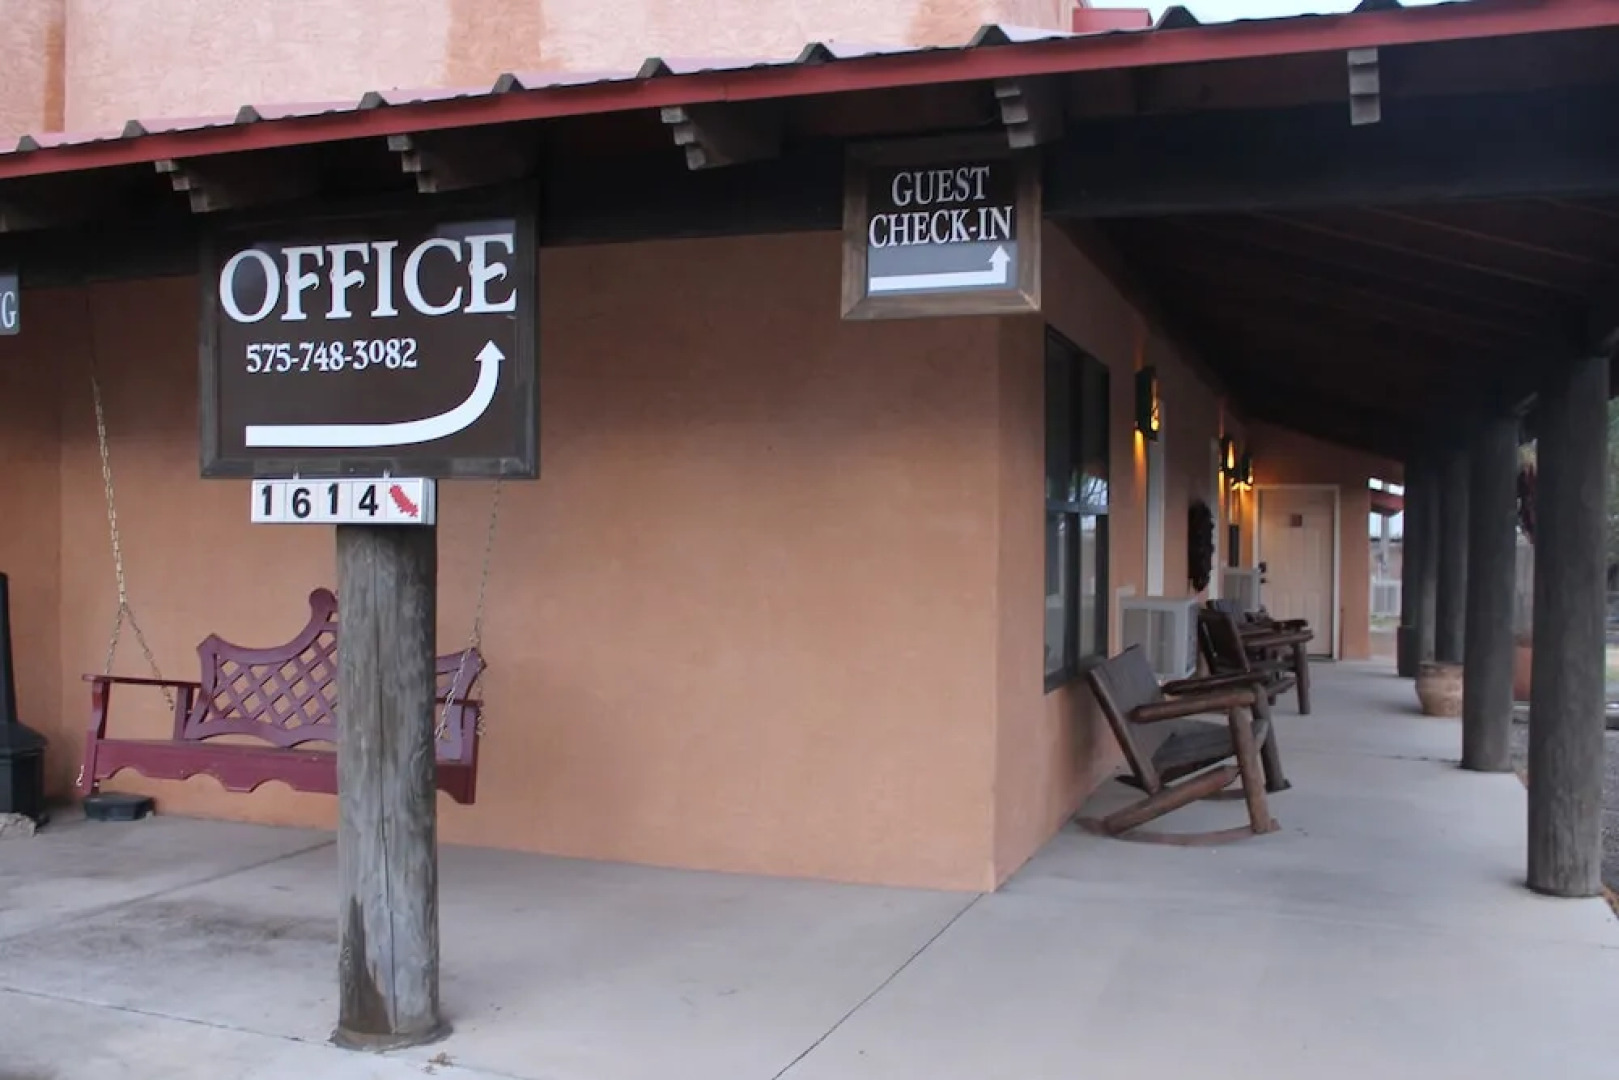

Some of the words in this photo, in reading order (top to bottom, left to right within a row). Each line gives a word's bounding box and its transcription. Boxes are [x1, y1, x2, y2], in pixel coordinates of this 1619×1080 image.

[891, 166, 990, 207] GUEST
[868, 205, 1013, 249] CHECK-IN
[219, 233, 517, 323] OFFICE
[0, 290, 17, 329] G
[245, 337, 418, 373] 575-748-3082
[262, 482, 379, 518] 1614
